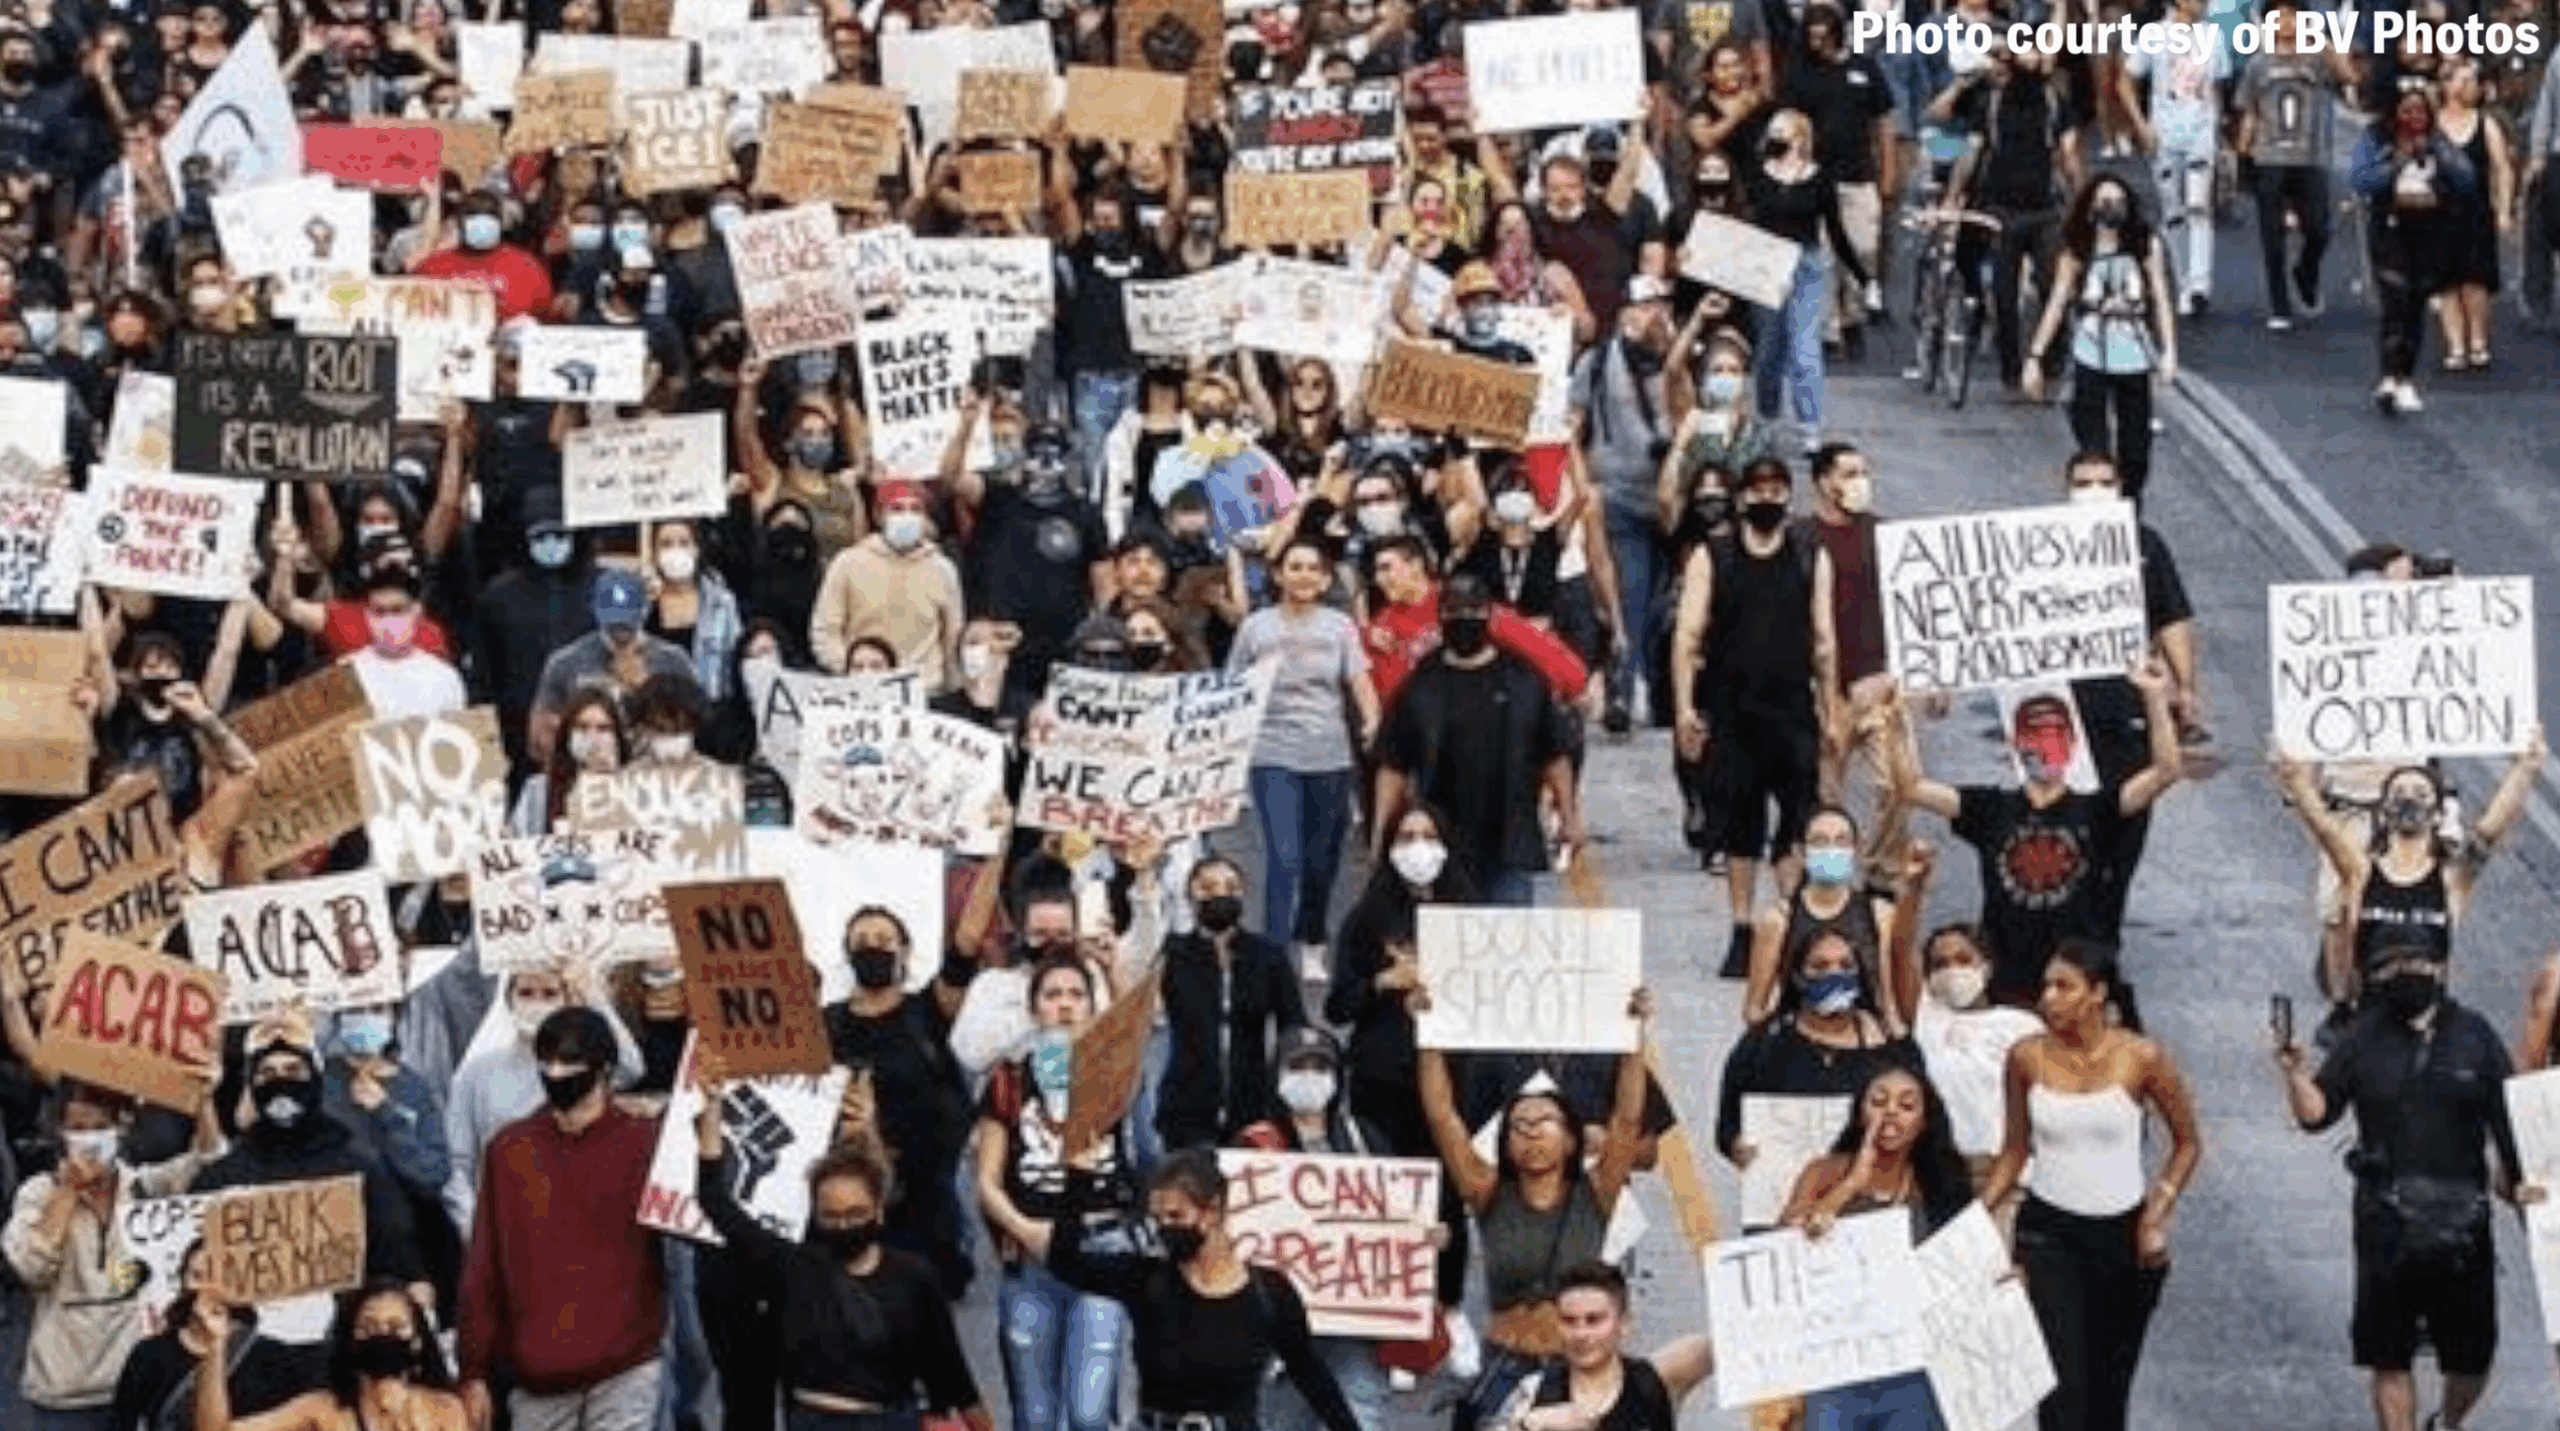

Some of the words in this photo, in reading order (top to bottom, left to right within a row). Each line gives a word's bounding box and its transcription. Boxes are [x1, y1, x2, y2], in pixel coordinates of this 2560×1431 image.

[306, 338, 394, 393] RIOT
[869, 332, 952, 367] BLACK
[249, 380, 275, 415] A
[874, 359, 950, 395] LIVES
[220, 418, 391, 473] REVOLUTION
[120, 484, 222, 522] DEFUND
[1894, 572, 2016, 642] NEVER
[2285, 584, 2461, 646] SILENCE
[2480, 581, 2520, 629] IS
[2280, 648, 2377, 699] NOT
[2410, 645, 2478, 688] AN
[2308, 692, 2514, 755] OPTION
[359, 718, 482, 820] NO
[1035, 759, 1104, 801] WE
[216, 893, 384, 983] ACAB
[479, 902, 536, 940] BAD
[696, 901, 776, 953] NO
[51, 956, 218, 1067] ACAB
[717, 985, 782, 1030] NO
[1441, 966, 1614, 1045] SHOOT
[1223, 1165, 1280, 1215] I
[1289, 1162, 1436, 1216] CAN'T
[221, 1189, 335, 1246] BLACK
